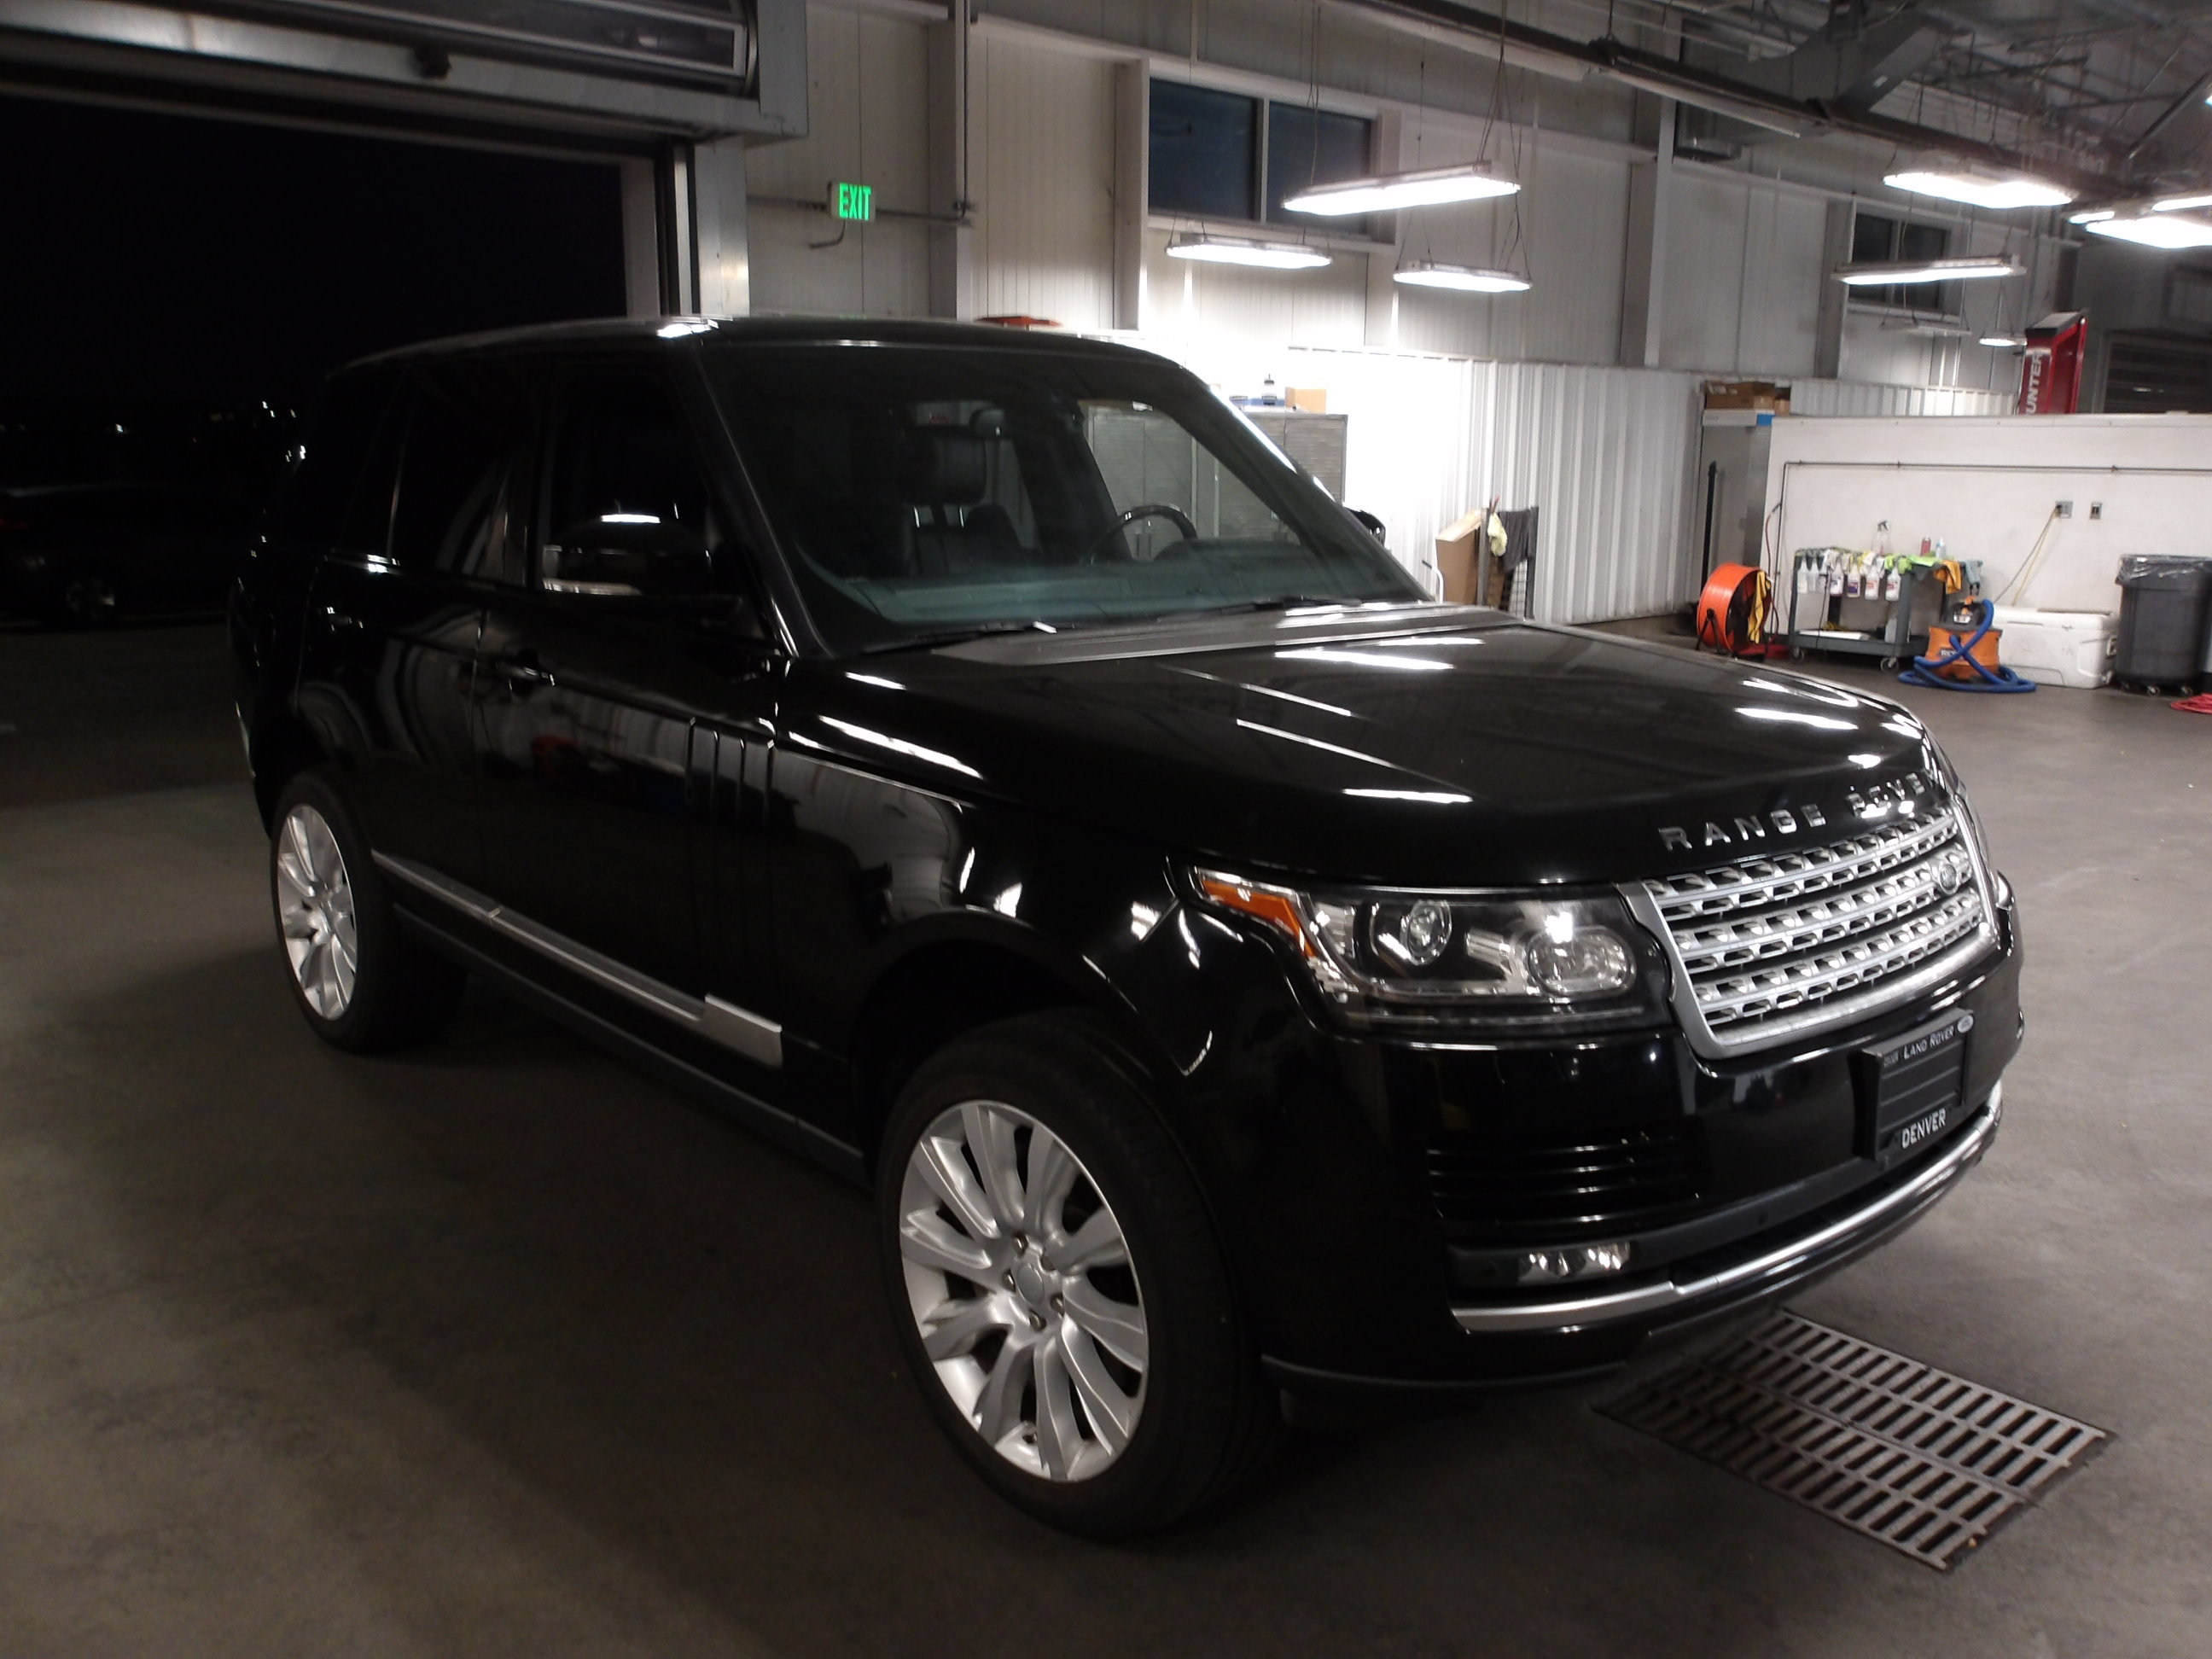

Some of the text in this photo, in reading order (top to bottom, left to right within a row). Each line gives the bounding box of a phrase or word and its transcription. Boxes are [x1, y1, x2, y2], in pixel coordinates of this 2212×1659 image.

[839, 183, 871, 220] EXIT
[2025, 351, 2043, 415] UNTER
[1657, 804, 1827, 851] RANGE
[1903, 1039, 1929, 1060] LAND
[1929, 1025, 1954, 1048] ROVER
[1901, 1108, 1947, 1149] DENVER
